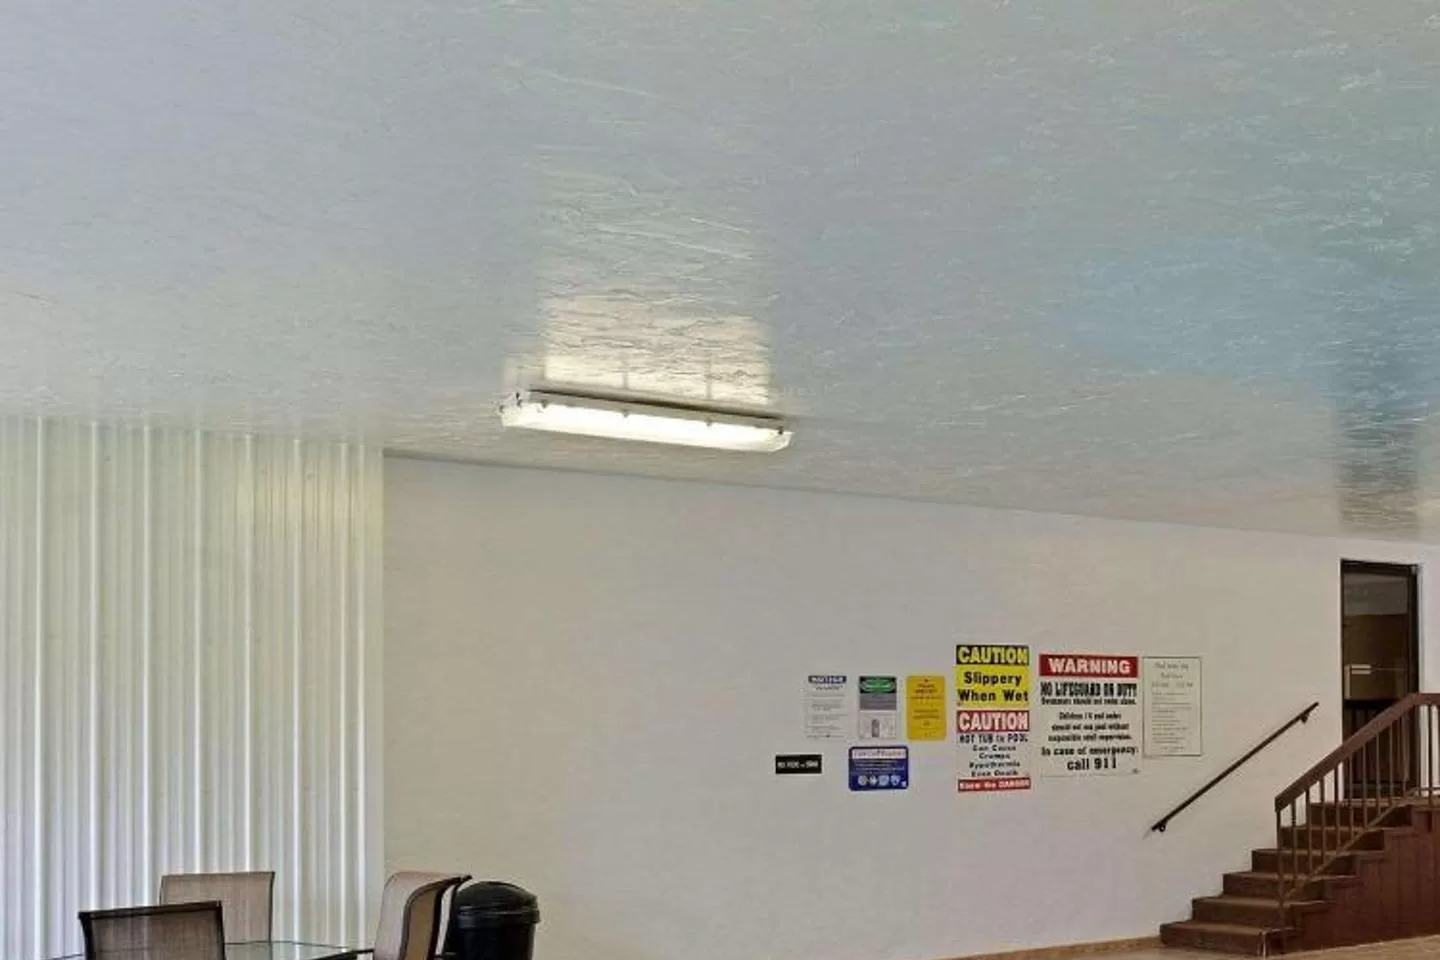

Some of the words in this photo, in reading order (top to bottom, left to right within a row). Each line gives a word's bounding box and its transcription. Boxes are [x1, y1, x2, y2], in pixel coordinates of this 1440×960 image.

[958, 646, 1028, 663] CAUTION
[1048, 658, 1131, 674] WARNING
[963, 671, 1022, 687] Slippery
[957, 689, 997, 701] When
[1003, 690, 1029, 702] Wet
[1041, 681, 1053, 697] NO
[959, 712, 1028, 731] CAUTION
[979, 734, 993, 743] TUB
[1041, 746, 1051, 756] In
[1053, 748, 1074, 756] case
[1077, 747, 1087, 755] of
[1067, 758, 1090, 770] call
[1094, 757, 1116, 769] 911
